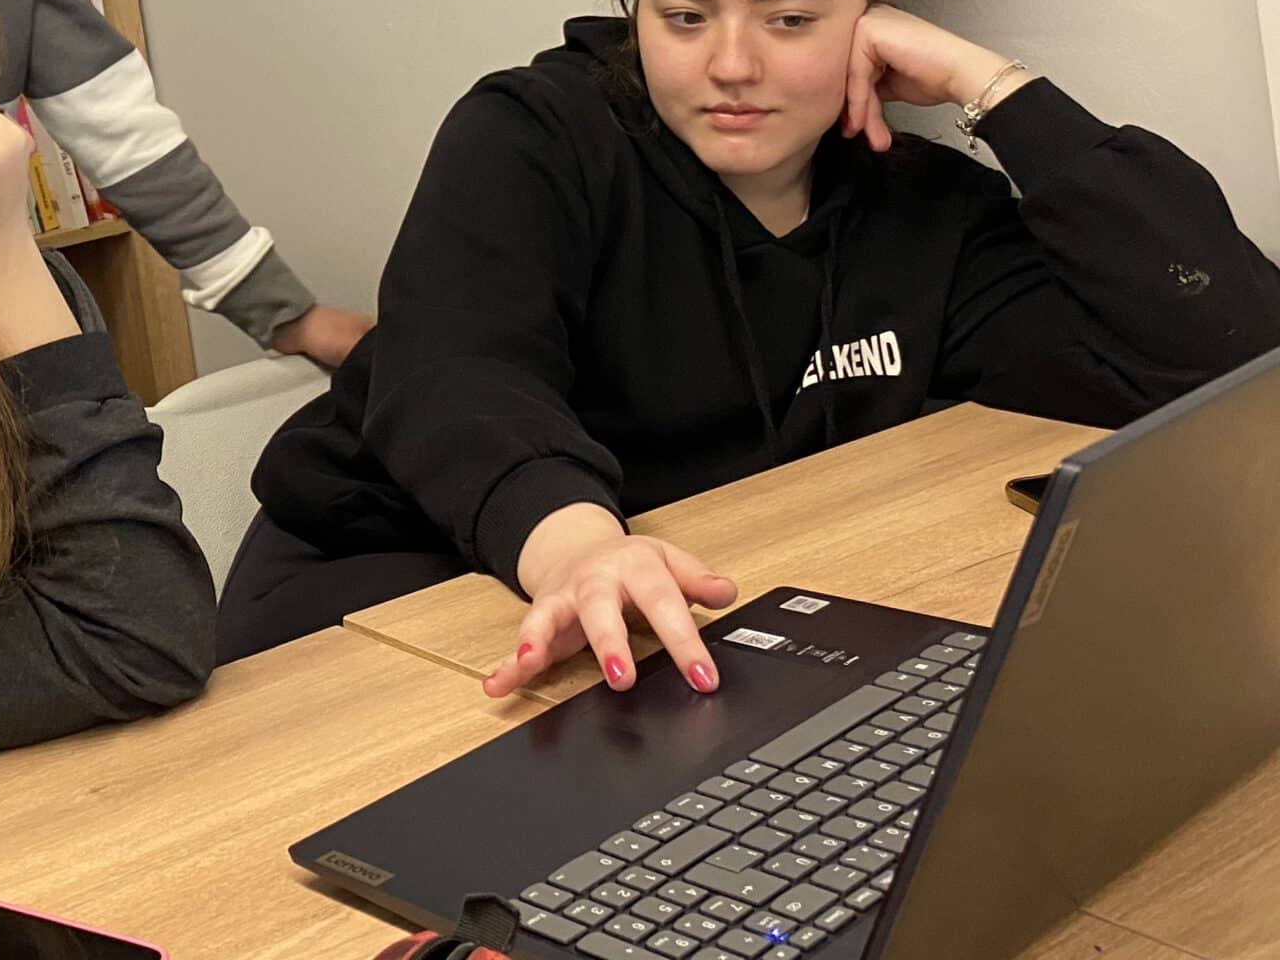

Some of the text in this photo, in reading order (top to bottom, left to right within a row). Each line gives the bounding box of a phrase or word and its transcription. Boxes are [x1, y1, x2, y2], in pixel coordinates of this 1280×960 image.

[922, 699, 935, 707] C
[849, 744, 864, 752] N
[904, 747, 919, 755] H
[822, 761, 838, 769] M
[852, 780, 868, 788] K
[878, 803, 893, 811] O
[591, 907, 604, 915] 3
[659, 904, 673, 912] 5
[730, 903, 743, 912] 7
[631, 922, 645, 930] 6
[702, 921, 716, 929] 8
[675, 939, 689, 947] 9
